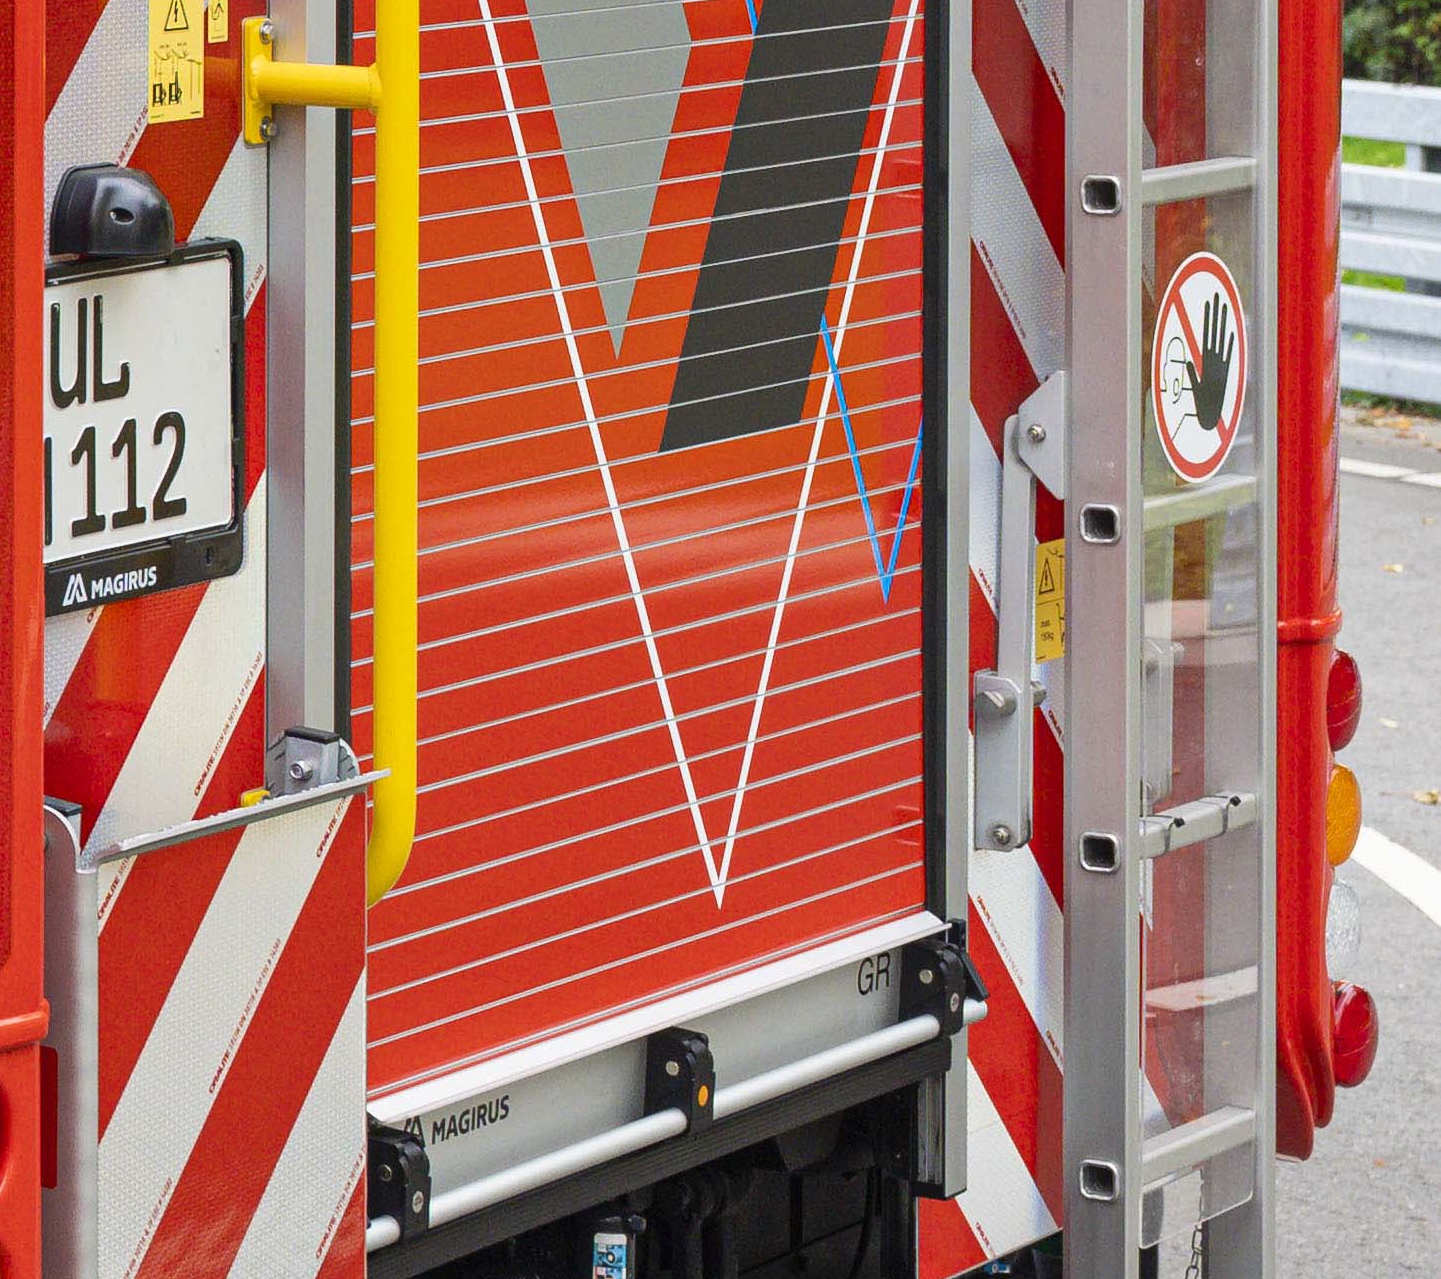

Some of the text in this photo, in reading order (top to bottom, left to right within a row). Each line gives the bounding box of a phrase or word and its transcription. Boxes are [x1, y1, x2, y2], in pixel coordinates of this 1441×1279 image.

[50, 294, 130, 409] UL
[90, 566, 157, 600] MAGIRUS
[857, 953, 892, 998] GR
[431, 1094, 511, 1145] MAGIRUS
